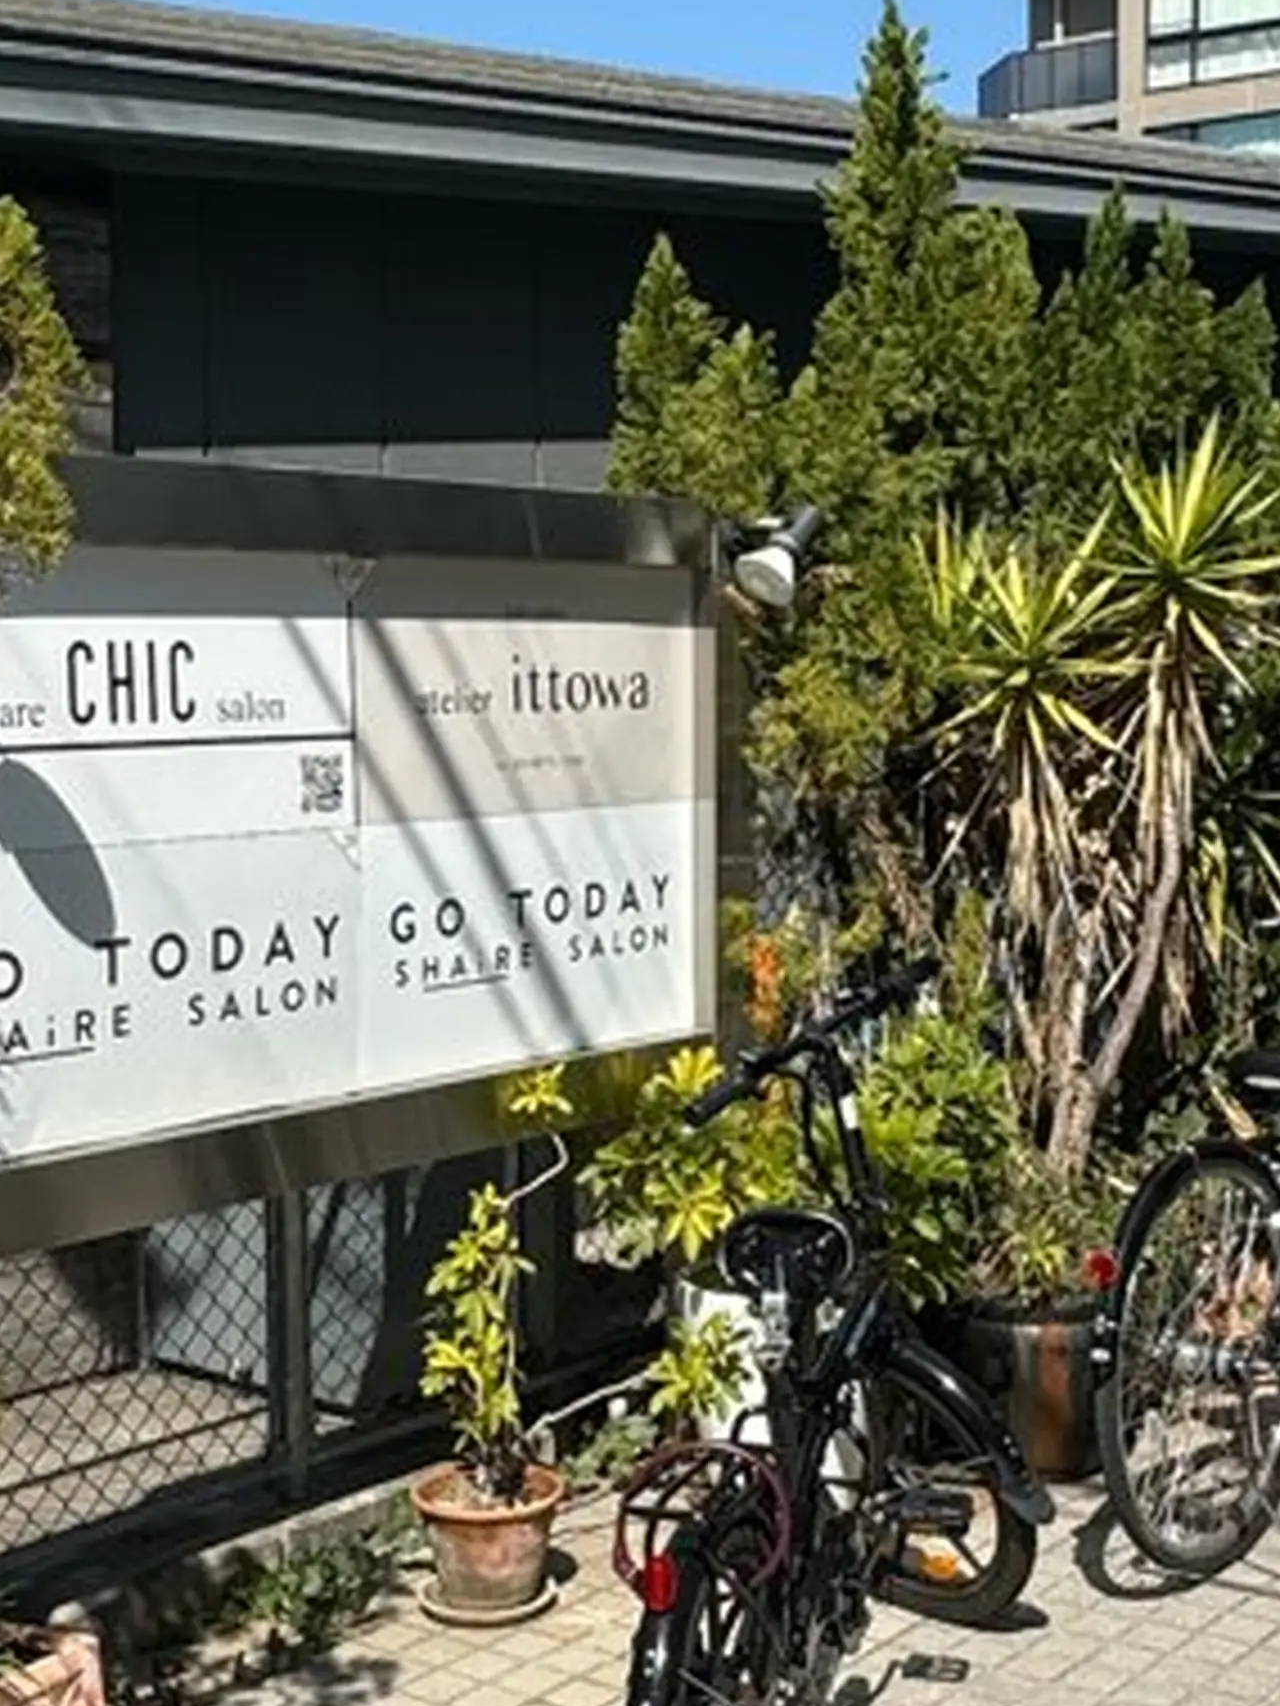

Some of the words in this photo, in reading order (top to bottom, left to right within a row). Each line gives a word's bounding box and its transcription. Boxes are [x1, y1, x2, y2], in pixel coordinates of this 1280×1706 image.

[67, 639, 196, 727] CHIC
[217, 691, 287, 724] salon
[512, 653, 650, 714] ittowa
[389, 897, 466, 944] GO
[507, 873, 670, 930] TODAY
[93, 913, 340, 986] TODAY
[568, 924, 670, 963] SALON
[187, 976, 338, 1026] SALON
